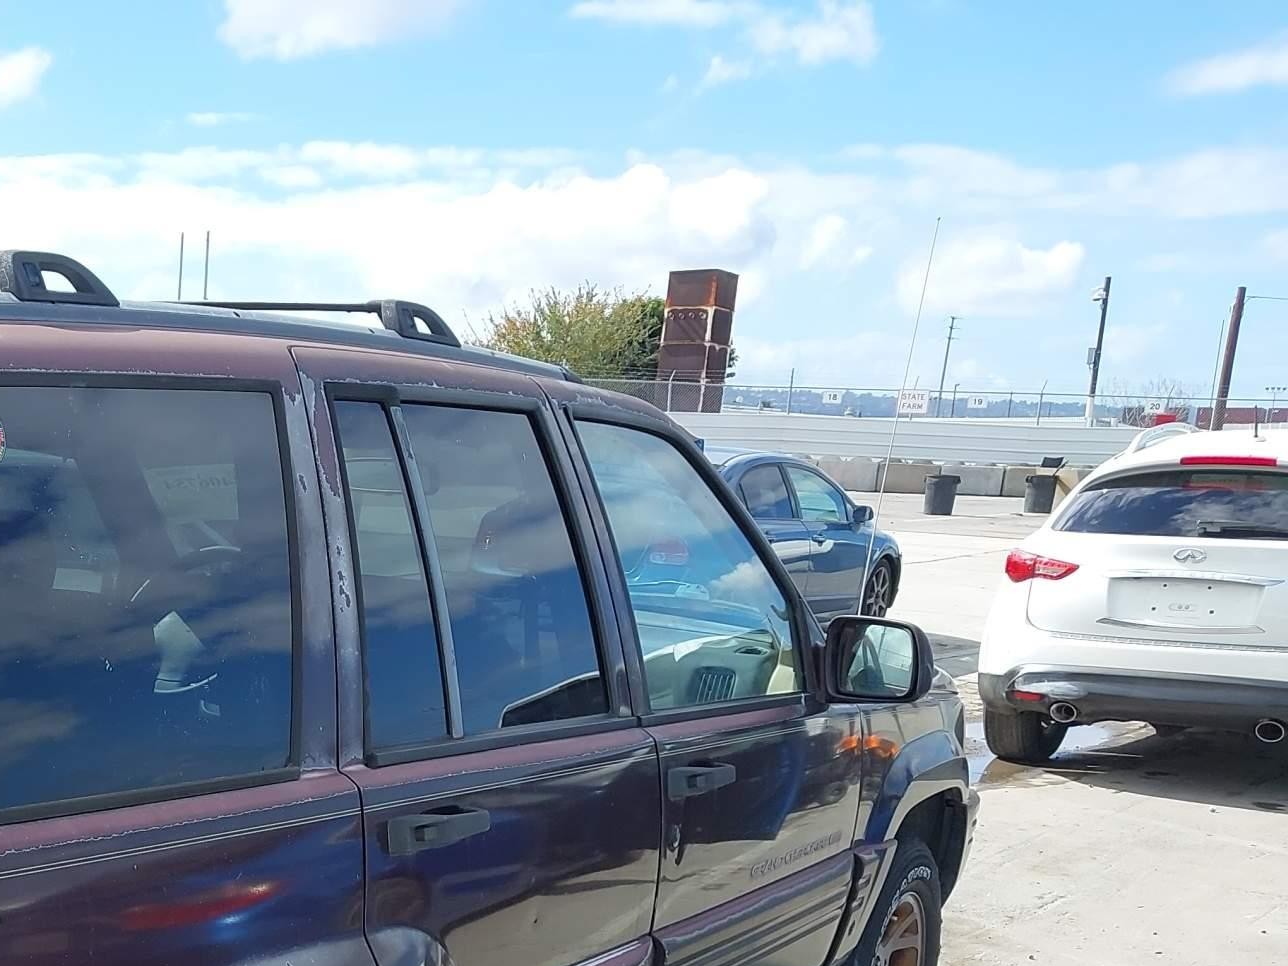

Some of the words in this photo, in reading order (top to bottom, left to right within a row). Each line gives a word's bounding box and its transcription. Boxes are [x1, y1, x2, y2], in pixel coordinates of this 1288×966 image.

[827, 393, 838, 401] 18
[901, 393, 926, 401] STATE
[901, 402, 924, 410] FARM
[972, 398, 983, 406] 19
